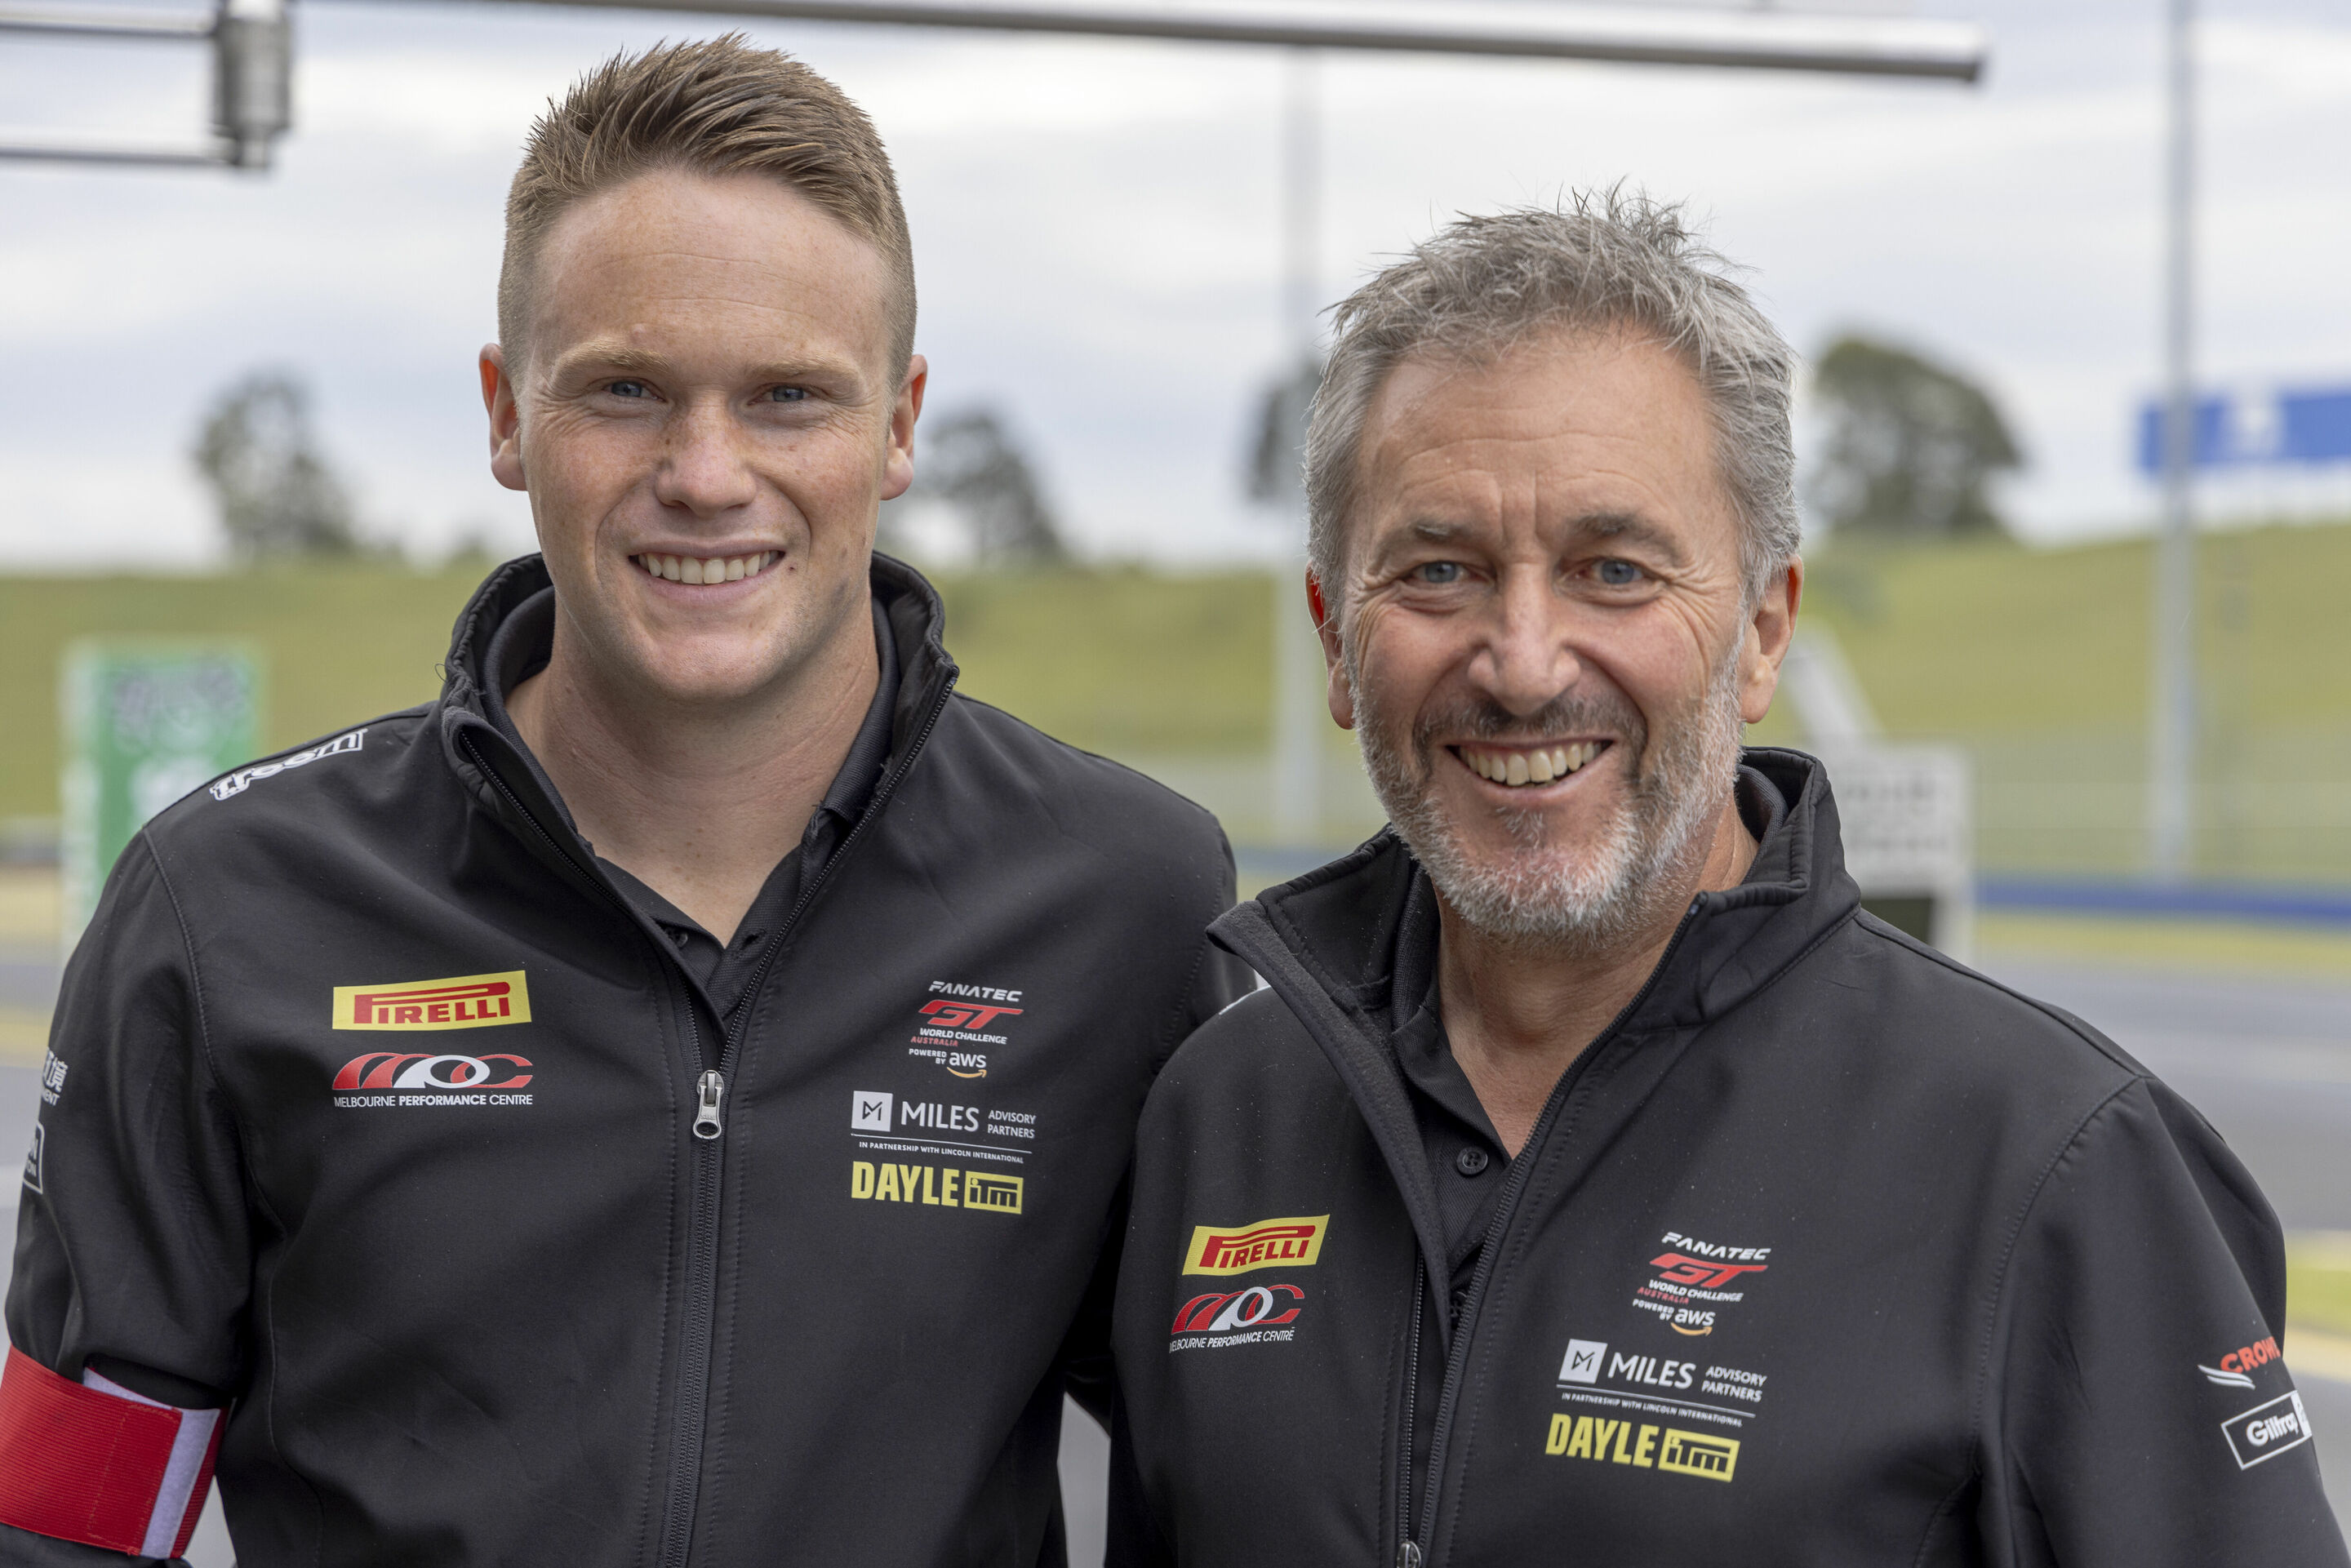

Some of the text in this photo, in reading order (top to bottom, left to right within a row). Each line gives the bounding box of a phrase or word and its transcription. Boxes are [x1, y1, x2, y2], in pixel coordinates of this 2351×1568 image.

[928, 980, 1023, 1002] FANATEC
[353, 982, 510, 1024] PIRELLI
[910, 1036, 958, 1047] AUSTRALIA
[919, 1028, 1007, 1045] WORLD CHALLENGE
[909, 1048, 947, 1058] POWERED
[949, 1052, 987, 1068] aws
[334, 1095, 533, 1108] MELBOURNE PERFORMANCE CENTRE
[900, 1101, 980, 1132] MILES
[988, 1110, 1037, 1125] ADVISORY
[987, 1124, 1035, 1139] PARTNERS
[869, 1143, 919, 1153] PARTNERSHIP
[920, 1146, 940, 1154] WITH
[941, 1148, 971, 1157] LINCOLN
[972, 1152, 1024, 1164] INTERNATIONAL
[851, 1161, 960, 1207] DAYLE
[1198, 1225, 1316, 1268] PIRELLI
[1661, 1232, 1771, 1260] FANATEC
[1637, 1286, 1689, 1304] AUSTRALIA
[1649, 1279, 1744, 1302] WORLD CHALLENGE
[1633, 1299, 1675, 1313] POWERED
[1660, 1312, 1672, 1321] BY
[1674, 1308, 1716, 1326] aws
[1207, 1332, 1262, 1348] PERFORMANCE
[1263, 1330, 1295, 1342] CENTRE
[1607, 1352, 1696, 1389] MILES
[1705, 1366, 1767, 1387] ADVISORY
[1701, 1379, 1763, 1403] PARTNERS
[1562, 1393, 1743, 1428] IN PARTNERSHIP WITH LINCOLN INTERNATIONAL
[1545, 1413, 1660, 1468] DAYLE
